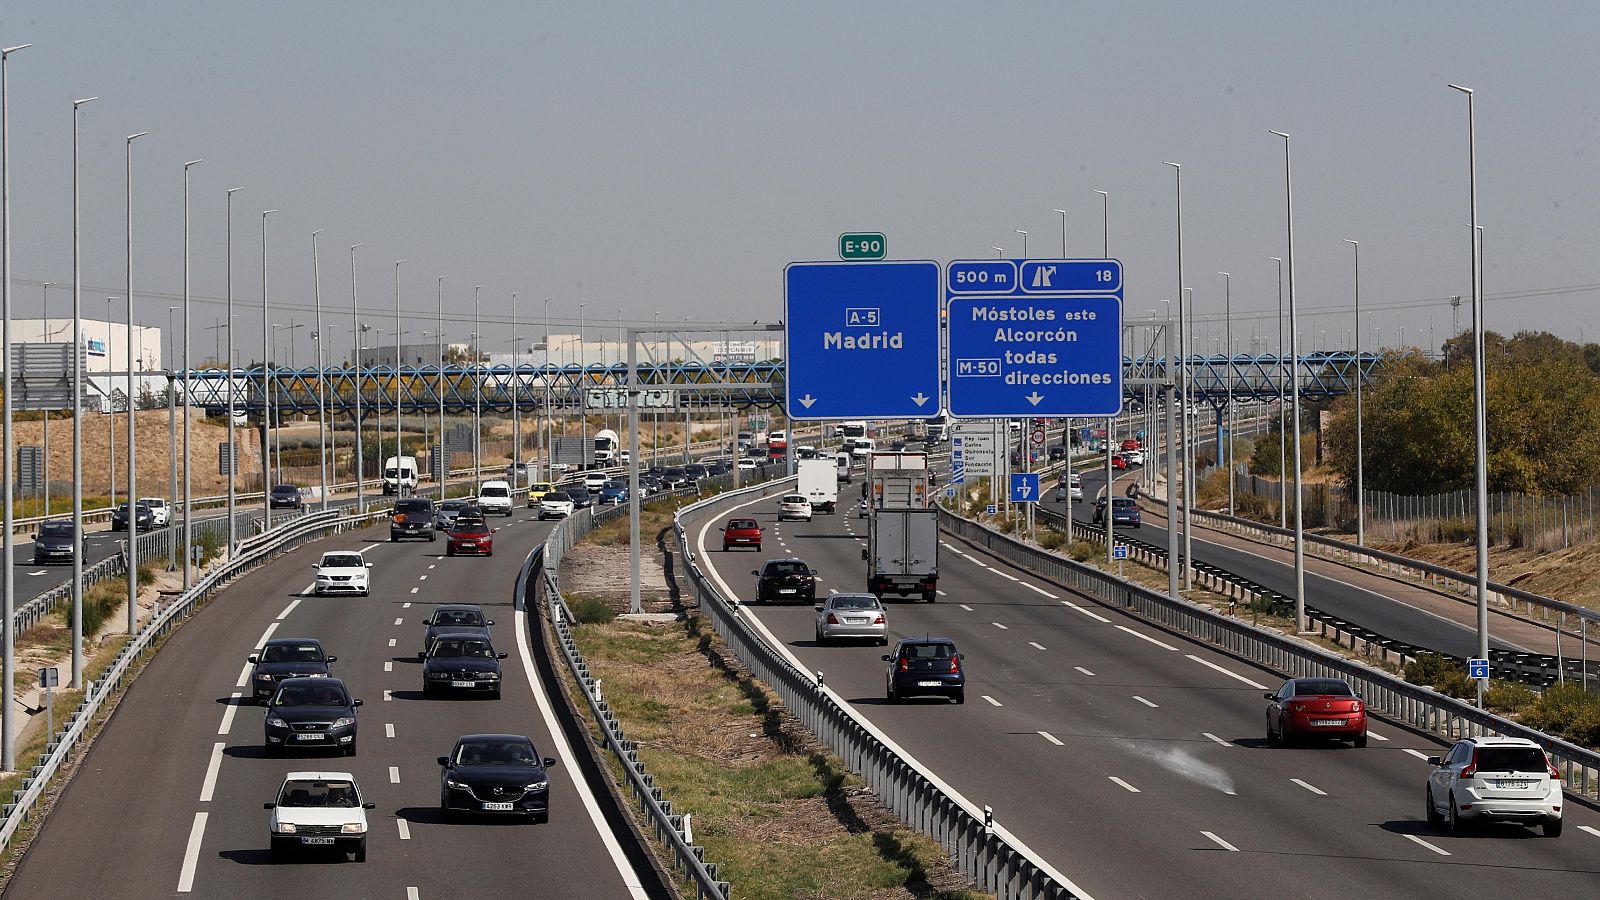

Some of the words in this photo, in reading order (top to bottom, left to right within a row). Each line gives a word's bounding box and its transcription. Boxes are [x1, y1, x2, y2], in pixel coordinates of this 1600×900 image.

[845, 241, 880, 252] E-90
[956, 271, 989, 283] 500
[995, 273, 1006, 282] m
[1096, 270, 1112, 282] 18
[850, 311, 877, 324] A-5
[972, 307, 1055, 321] Móstoles
[1066, 310, 1097, 321] este
[824, 332, 903, 349] Madrid
[995, 328, 1077, 342] Alcorcón
[1005, 350, 1057, 364] todas
[959, 361, 998, 374] M-50
[1005, 371, 1112, 385] direcciones
